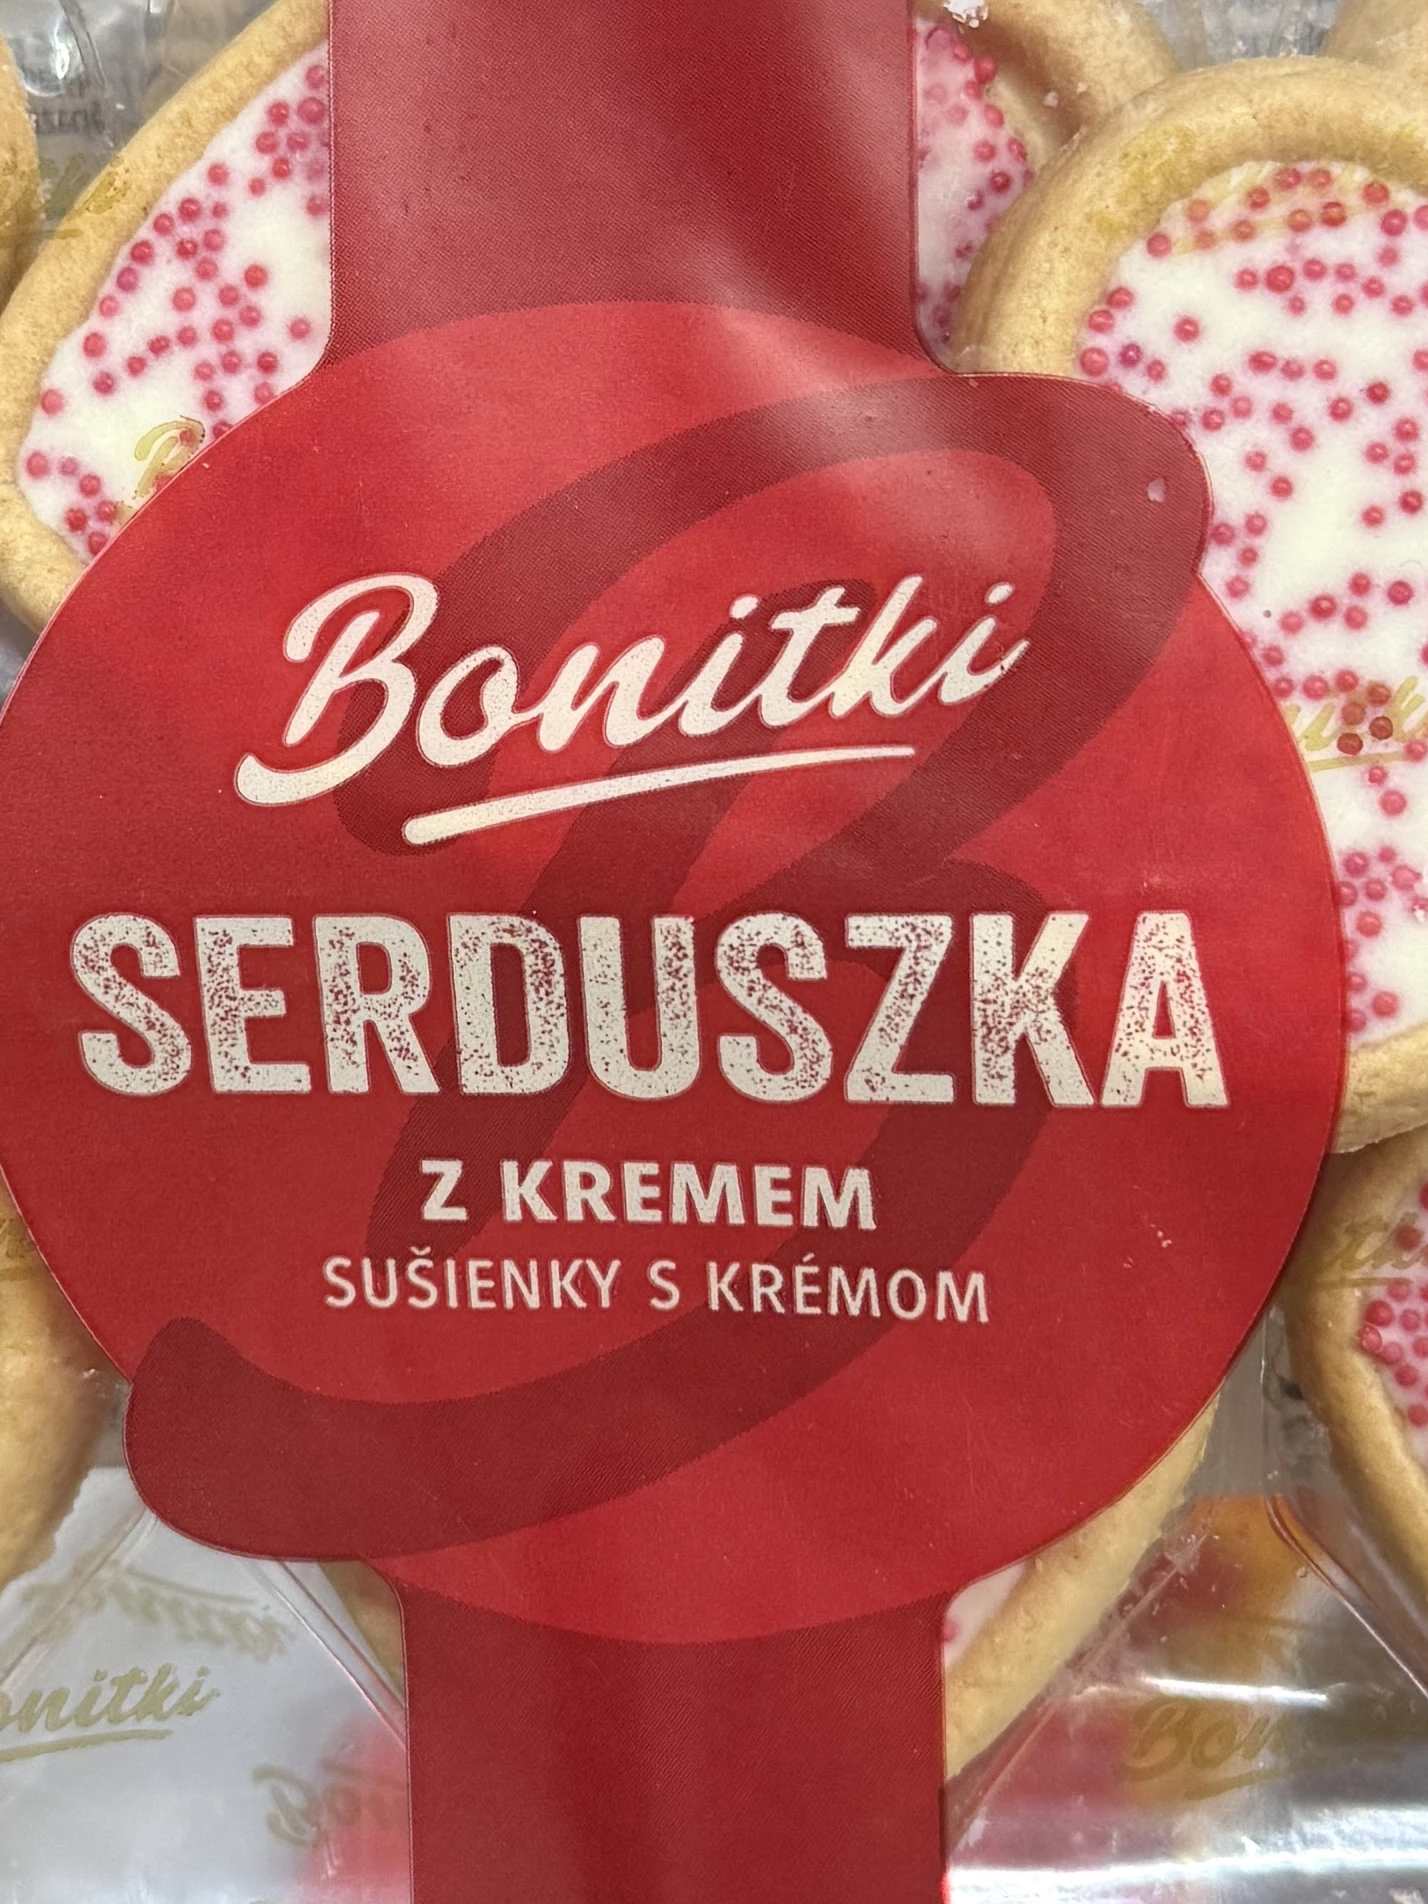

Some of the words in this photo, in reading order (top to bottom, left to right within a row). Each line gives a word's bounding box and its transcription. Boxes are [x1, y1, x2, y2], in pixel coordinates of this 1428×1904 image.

[235, 573, 1030, 807] Bonitki
[70, 909, 1231, 1108] SERDUSZKA
[420, 1159, 470, 1222] Z
[500, 1159, 877, 1230] KREMEM
[322, 1245, 623, 1310] SUŠIENKY
[647, 1259, 678, 1311] S
[708, 1252, 991, 1324] KRÉMOM
